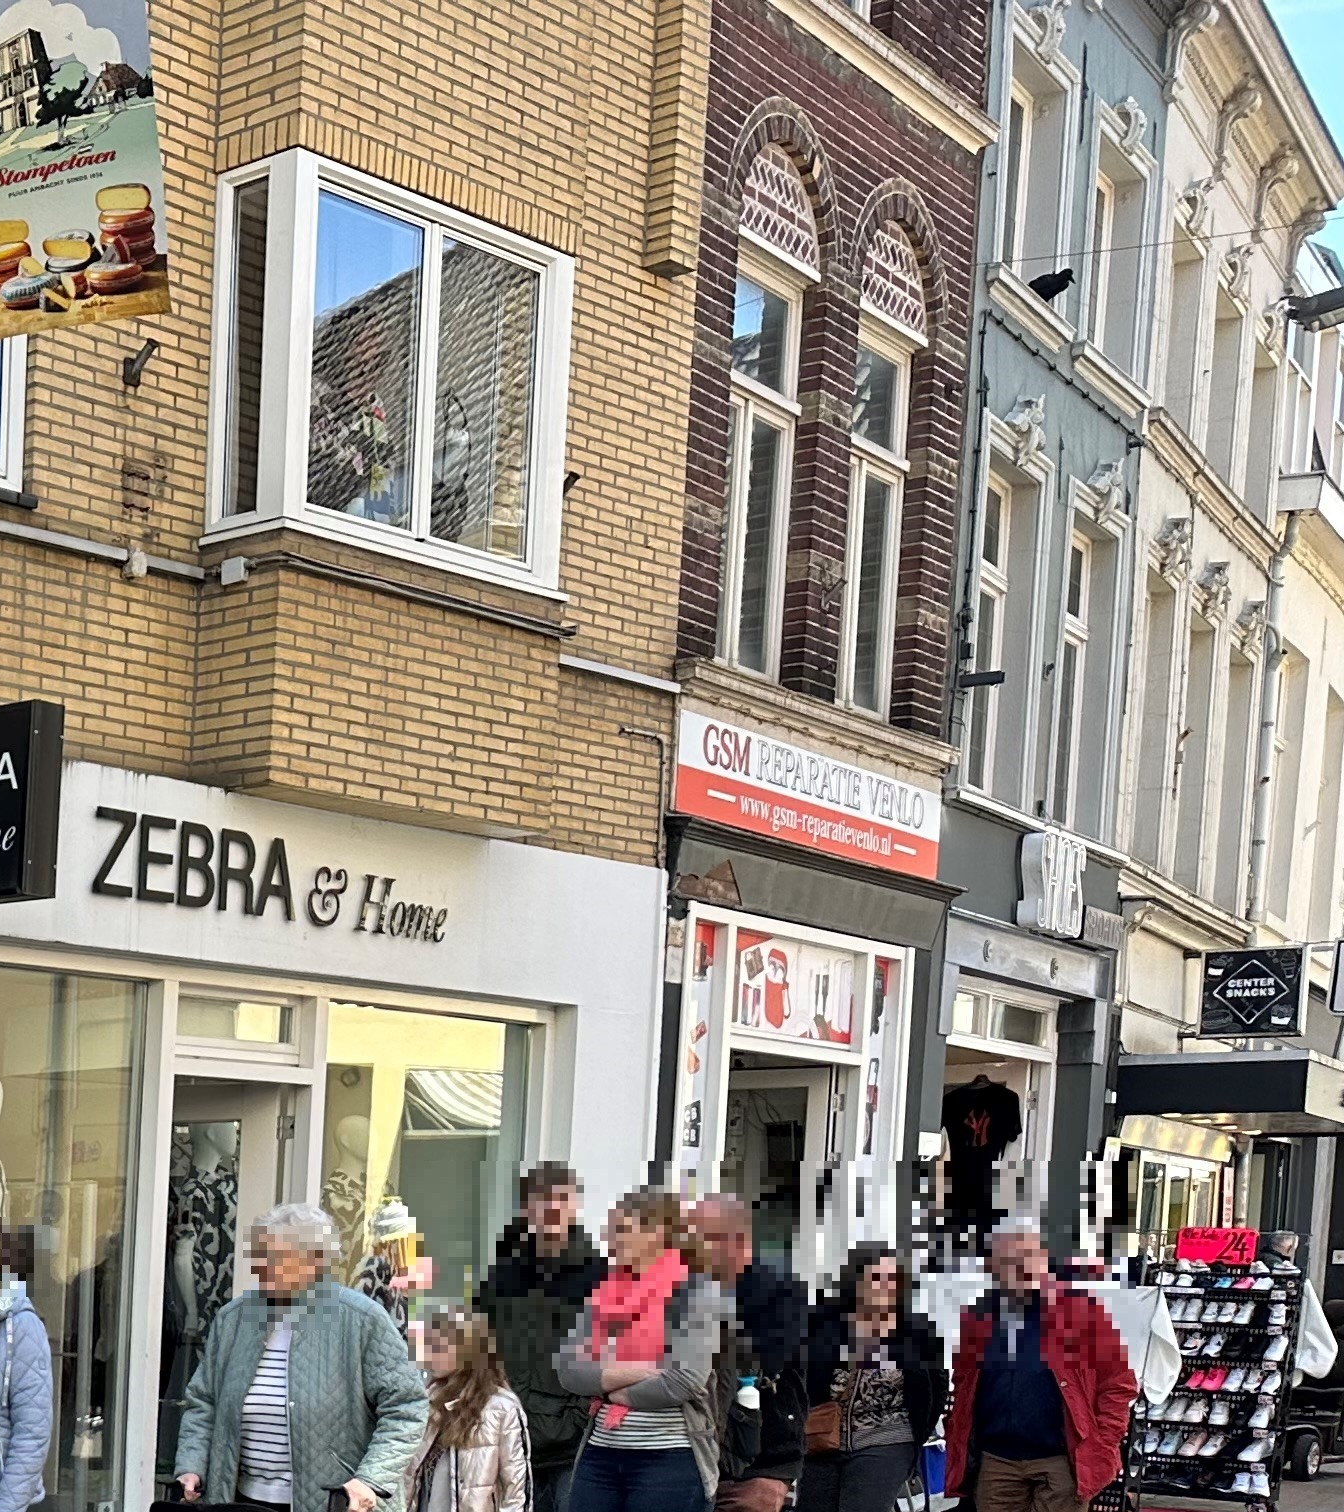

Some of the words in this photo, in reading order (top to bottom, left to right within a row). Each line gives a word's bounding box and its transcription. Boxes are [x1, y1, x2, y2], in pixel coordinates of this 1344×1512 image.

[703, 723, 752, 777] GSM
[756, 739, 862, 811] REPARATIE
[867, 775, 925, 829] VENLO
[740, 794, 893, 857] www.gsm-reparatievenlo.nl
[92, 806, 296, 922] ZEBRA
[305, 866, 349, 927] &
[354, 874, 449, 944] Home
[1225, 988, 1276, 998] SNACKS
[1227, 977, 1275, 988] CENTER
